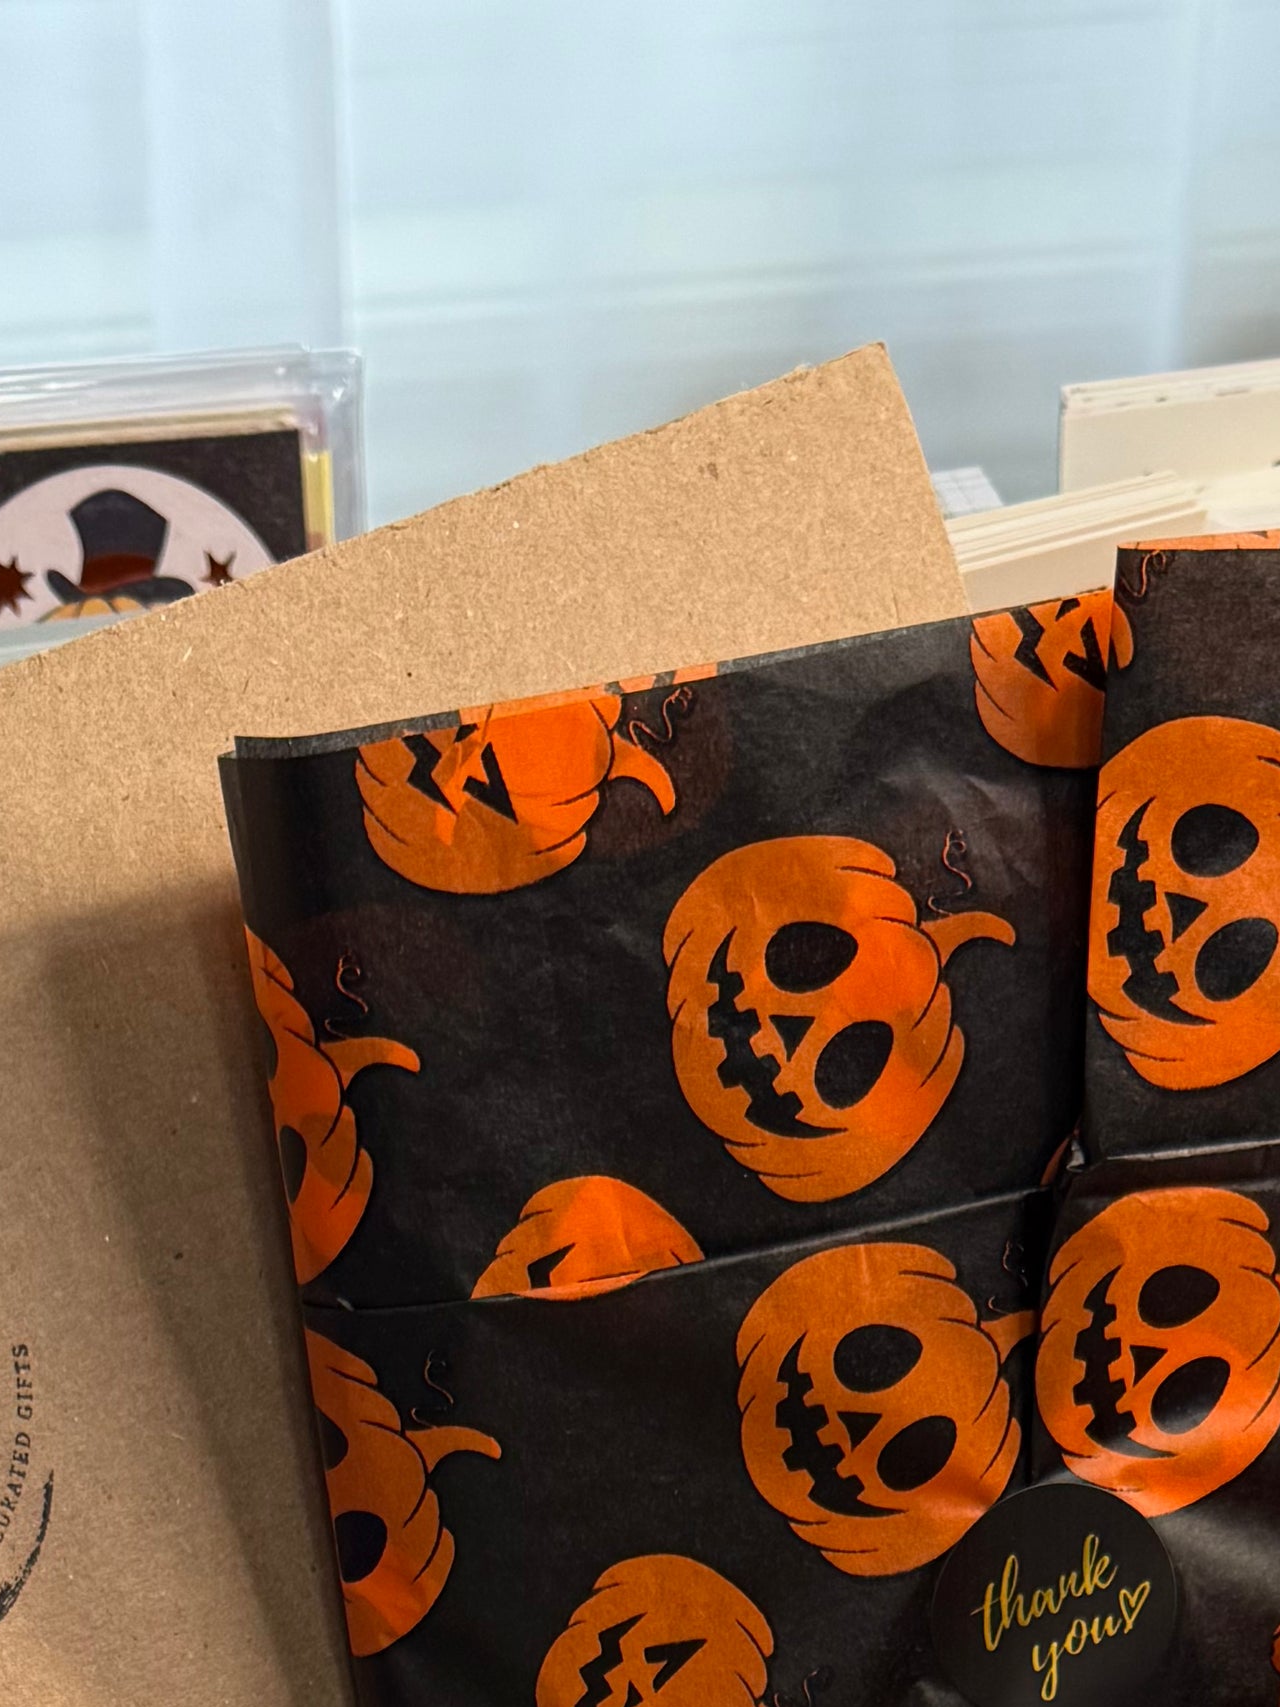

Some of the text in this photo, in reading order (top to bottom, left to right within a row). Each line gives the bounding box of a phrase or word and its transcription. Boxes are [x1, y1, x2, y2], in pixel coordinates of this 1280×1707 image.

[12, 1343, 33, 1420] GIFTS
[970, 1534, 1118, 1651] thank
[1031, 1614, 1122, 1701] you
